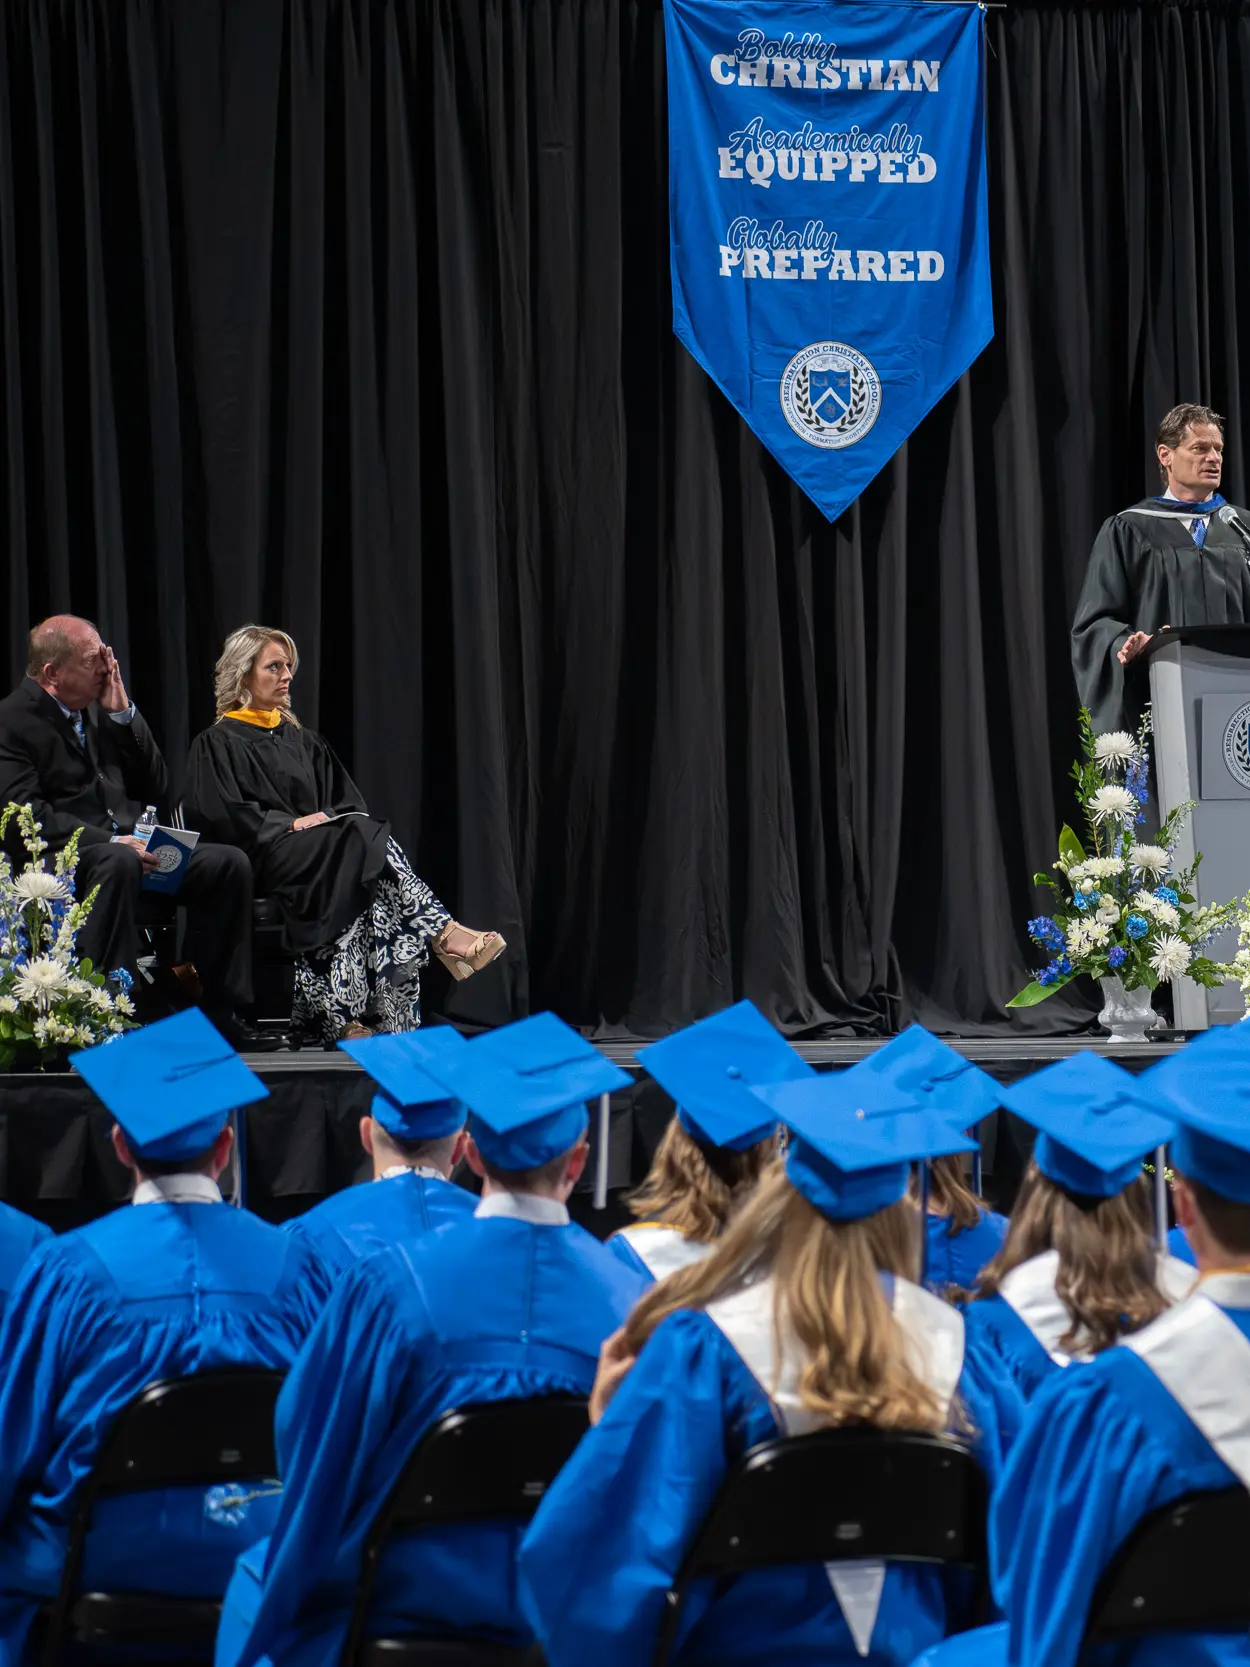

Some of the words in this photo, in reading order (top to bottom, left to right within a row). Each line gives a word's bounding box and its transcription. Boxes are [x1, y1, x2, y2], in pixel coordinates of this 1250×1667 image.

[735, 28, 837, 69] Boldly
[710, 54, 940, 92] CHRISTIAN
[729, 116, 922, 164] Academically
[718, 147, 937, 189] EQUIPPED
[727, 216, 837, 262] Globally
[719, 246, 945, 282] PREPARED
[783, 346, 820, 402] RESURRECTION
[822, 345, 866, 368] CHRISTIAN
[864, 366, 878, 402] SCHOOL
